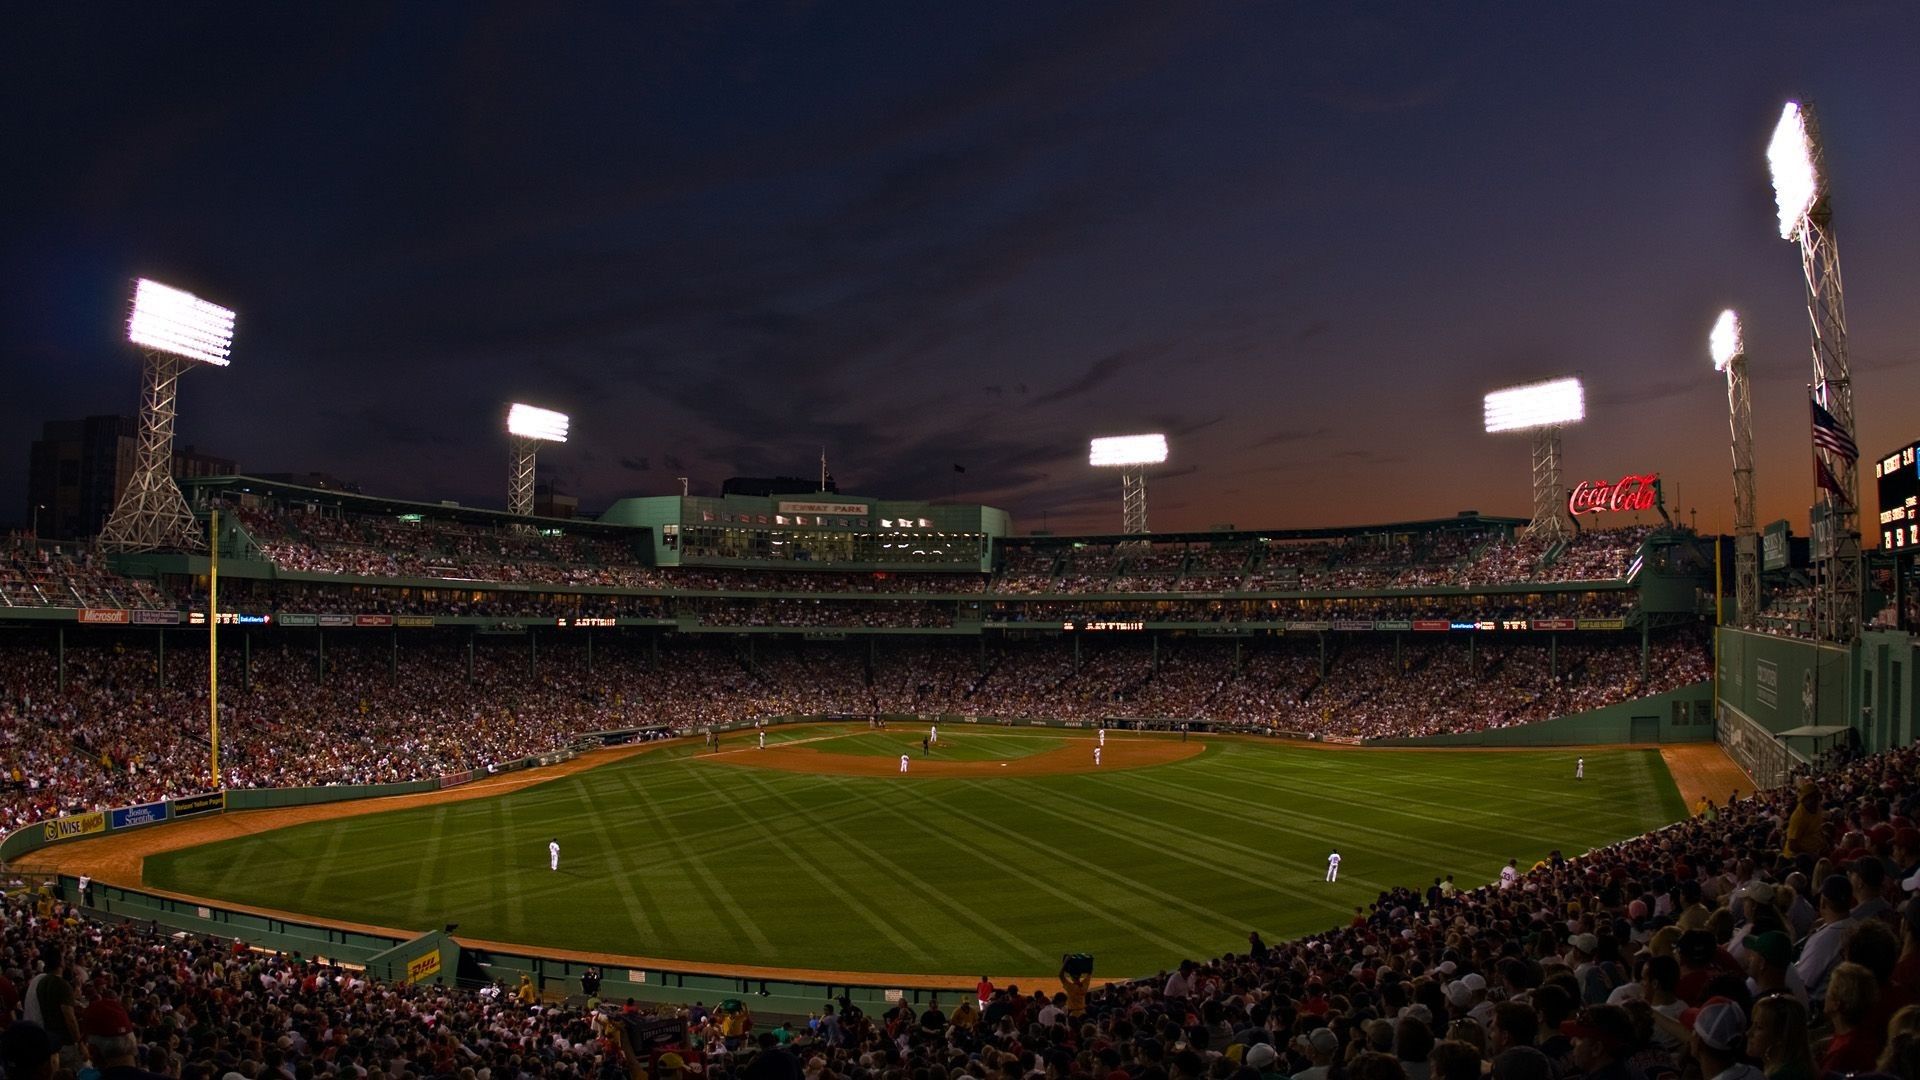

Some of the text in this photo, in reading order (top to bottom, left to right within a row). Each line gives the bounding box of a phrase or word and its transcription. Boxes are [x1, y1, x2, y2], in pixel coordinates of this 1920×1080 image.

[1569, 473, 1656, 515] Coca-Cola
[833, 504, 862, 512] PARK
[84, 611, 122, 621] Microsoft
